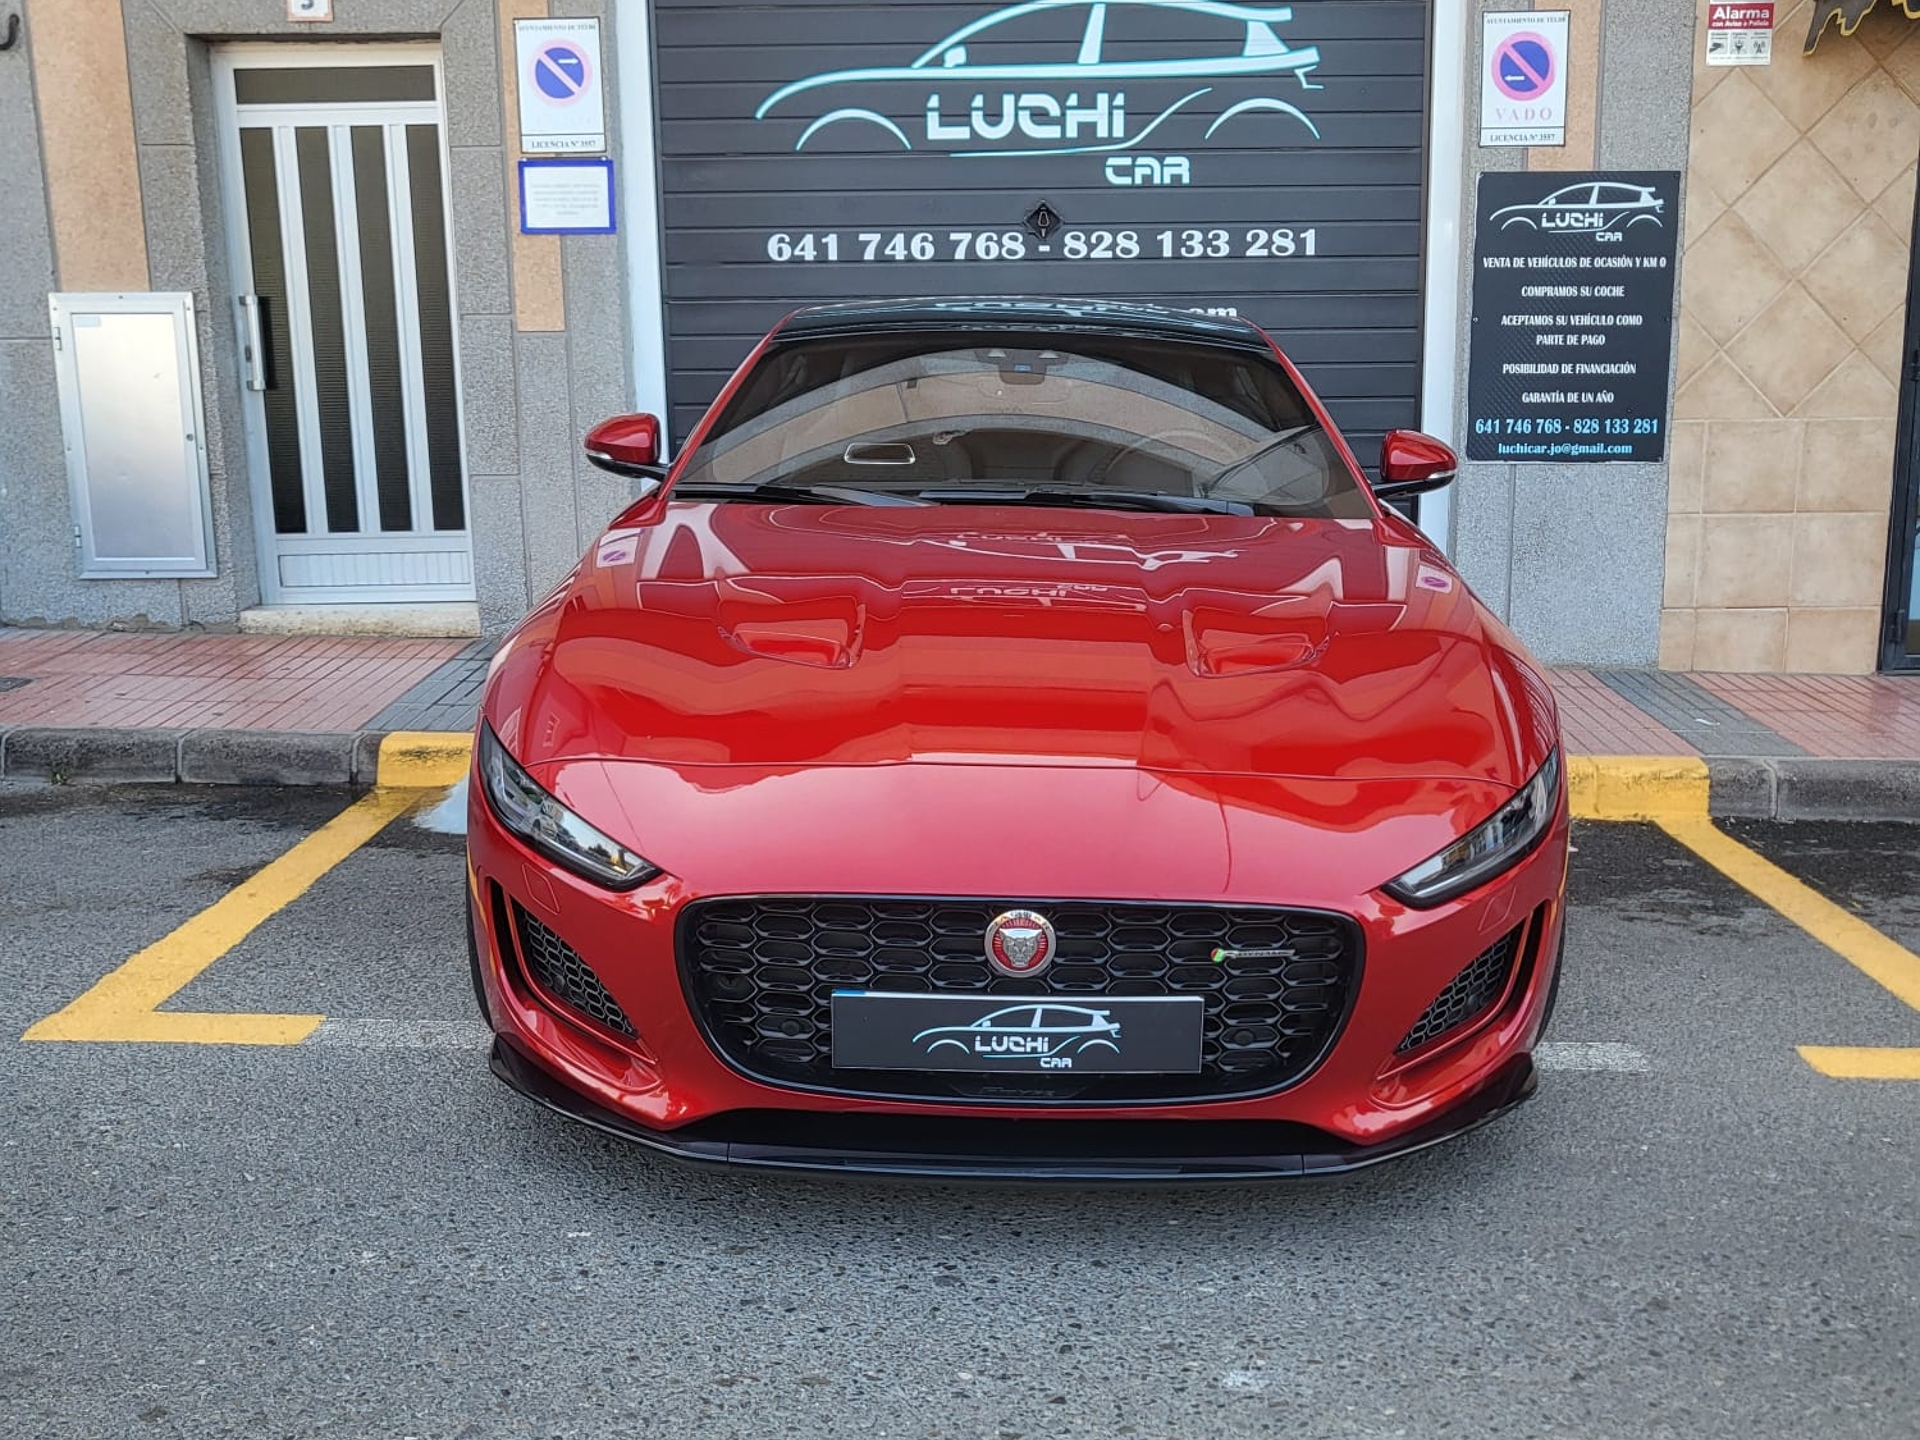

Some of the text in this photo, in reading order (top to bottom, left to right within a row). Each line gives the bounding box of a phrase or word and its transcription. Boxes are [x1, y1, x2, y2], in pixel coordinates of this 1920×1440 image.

[1713, 6, 1770, 19] Alarma
[1495, 106, 1553, 121] VADO
[1490, 133, 1528, 142] LICENCIA
[1104, 155, 1191, 186] CAR
[1595, 231, 1624, 242] CAR
[766, 232, 839, 262] 641
[858, 232, 935, 262] 746
[949, 231, 1026, 261] 768
[1063, 230, 1140, 259] 828
[1156, 229, 1230, 259] 133
[1245, 228, 1317, 257] 281
[1483, 256, 1511, 269] VENTA
[1512, 256, 1525, 269] DE
[1527, 254, 1577, 269] VEHÍCULOS
[1579, 256, 1593, 269] DE
[1594, 253, 1633, 268] OCASIÓN
[1635, 257, 1641, 268] Y
[1643, 256, 1658, 268] KM
[1521, 285, 1625, 298] COMPRAMOS SU COCHE
[1501, 312, 1643, 326] ACEPTAMOS SU VEHÍCULO COMO
[1536, 334, 1606, 346] PARTE DE PAGO
[1502, 360, 1637, 375] POSIBILIDAD DE FINANCIACIÓN
[1522, 389, 1615, 404] GARANTÍA DE UN AÑO
[1475, 418, 1501, 434] 641
[1505, 418, 1532, 434] 746
[1536, 418, 1562, 434] 768
[1573, 418, 1600, 434] 828
[1604, 418, 1630, 434] 133
[1633, 418, 1658, 434] 281
[1498, 442, 1633, 456] luchicar.jo@gmail.com
[1040, 1057, 1073, 1068] CAR
